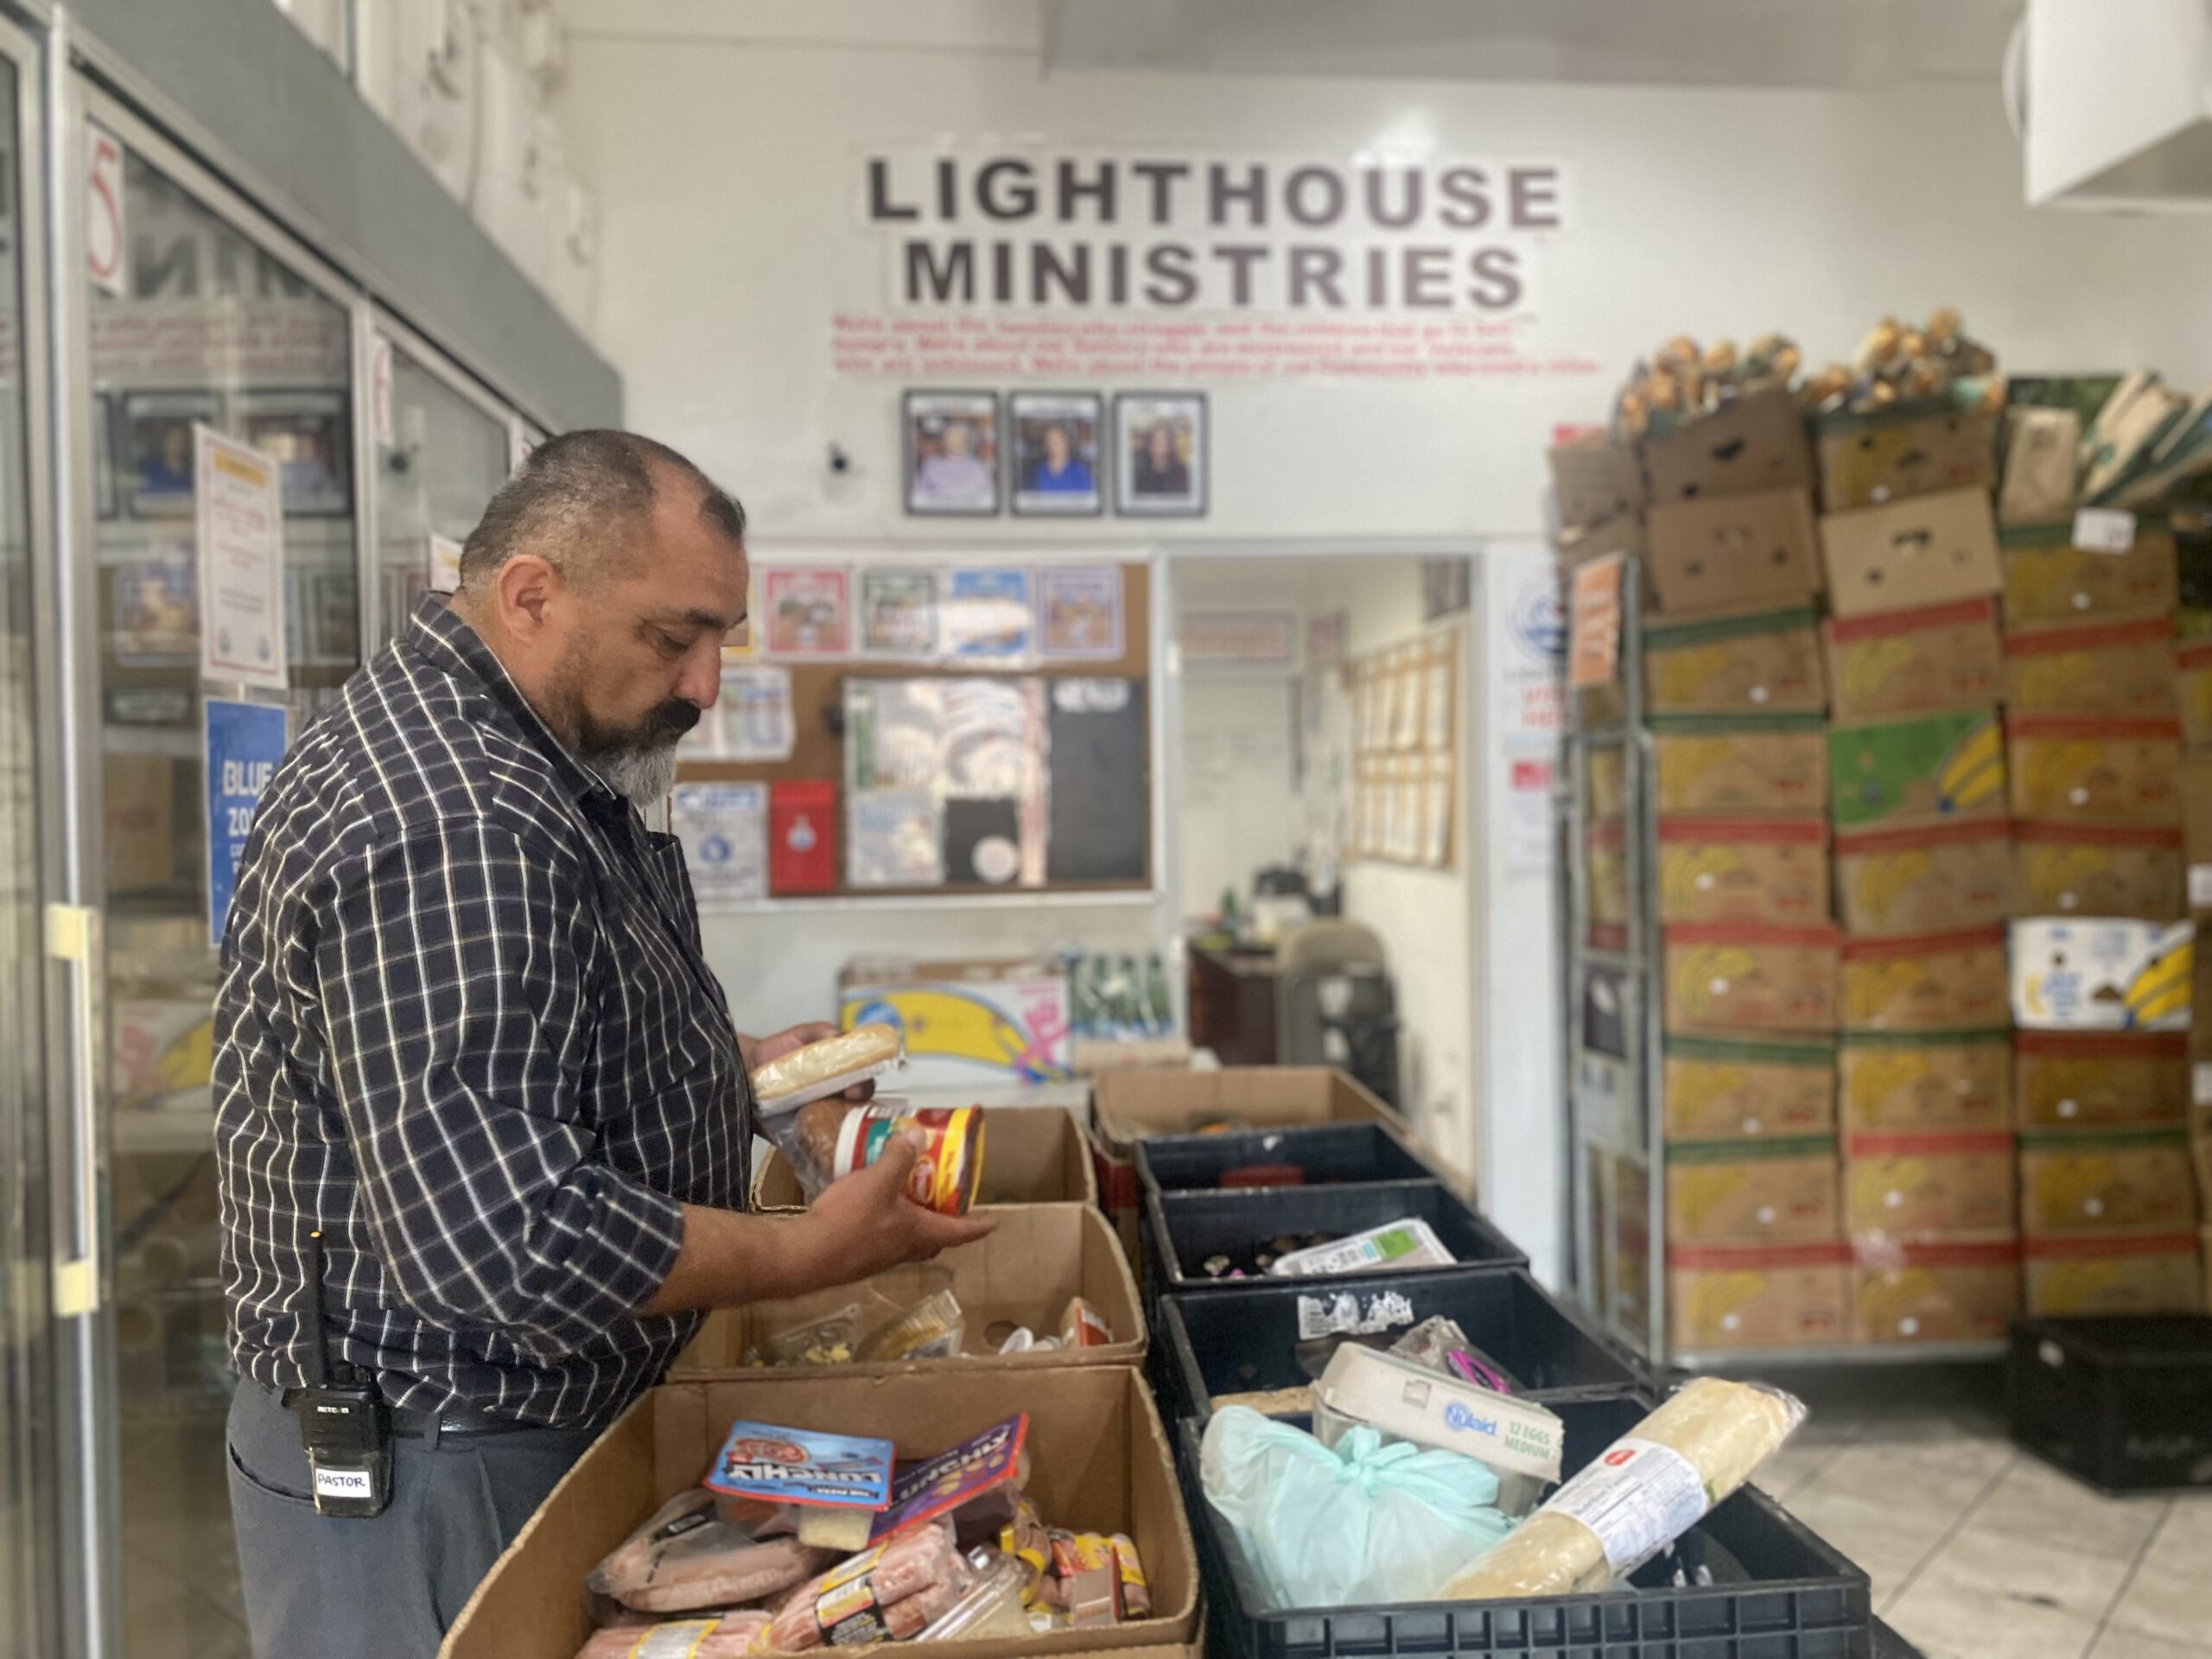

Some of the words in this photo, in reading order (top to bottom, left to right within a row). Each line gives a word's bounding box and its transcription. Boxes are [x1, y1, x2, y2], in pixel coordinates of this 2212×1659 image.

[868, 157, 1561, 229] LIGHTHOUSE
[905, 240, 1526, 308] MINISTRIES
[1510, 1422, 1521, 1436] 12
[1523, 1427, 1551, 1445] EGGS
[1504, 1435, 1550, 1460] MEDIUM
[318, 1473, 366, 1487] PASTOR
[728, 1461, 882, 1484] LUNCHLY
